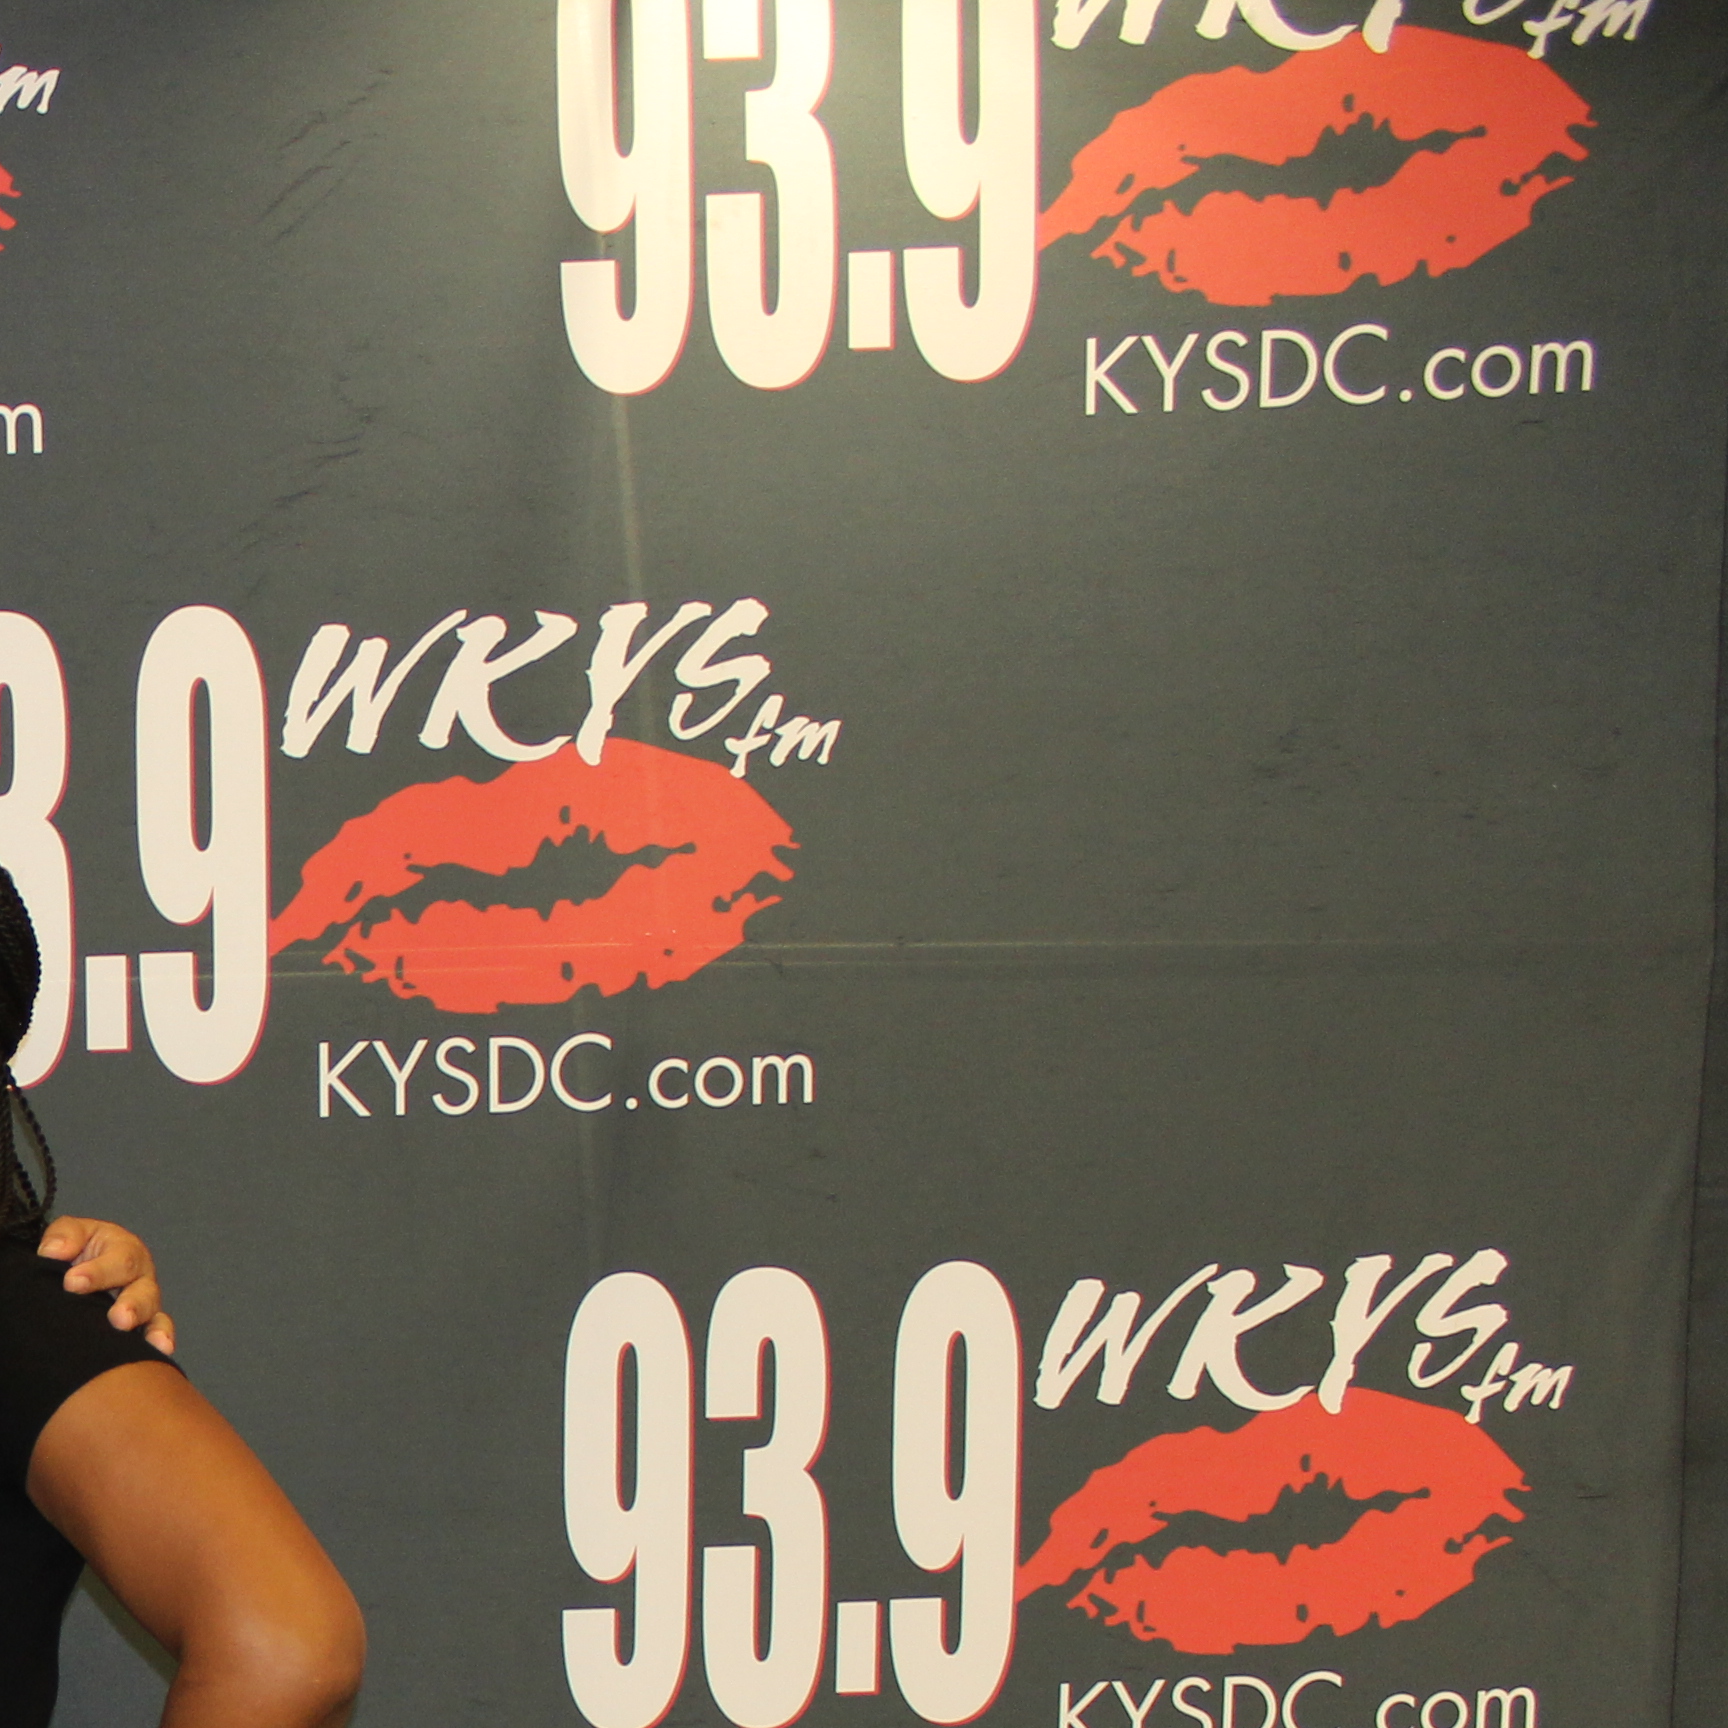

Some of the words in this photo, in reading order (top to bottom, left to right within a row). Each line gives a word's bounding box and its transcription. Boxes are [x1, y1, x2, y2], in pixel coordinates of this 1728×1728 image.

[556, 0, 1039, 394] 93.9
[1086, 324, 1593, 415] KYSDC.com
[280, 598, 770, 766] WKYS
[725, 695, 840, 778] fm
[318, 1033, 813, 1118] KYSDC.com
[1034, 1249, 1507, 1414] WKYS
[1461, 1343, 1572, 1423] fm
